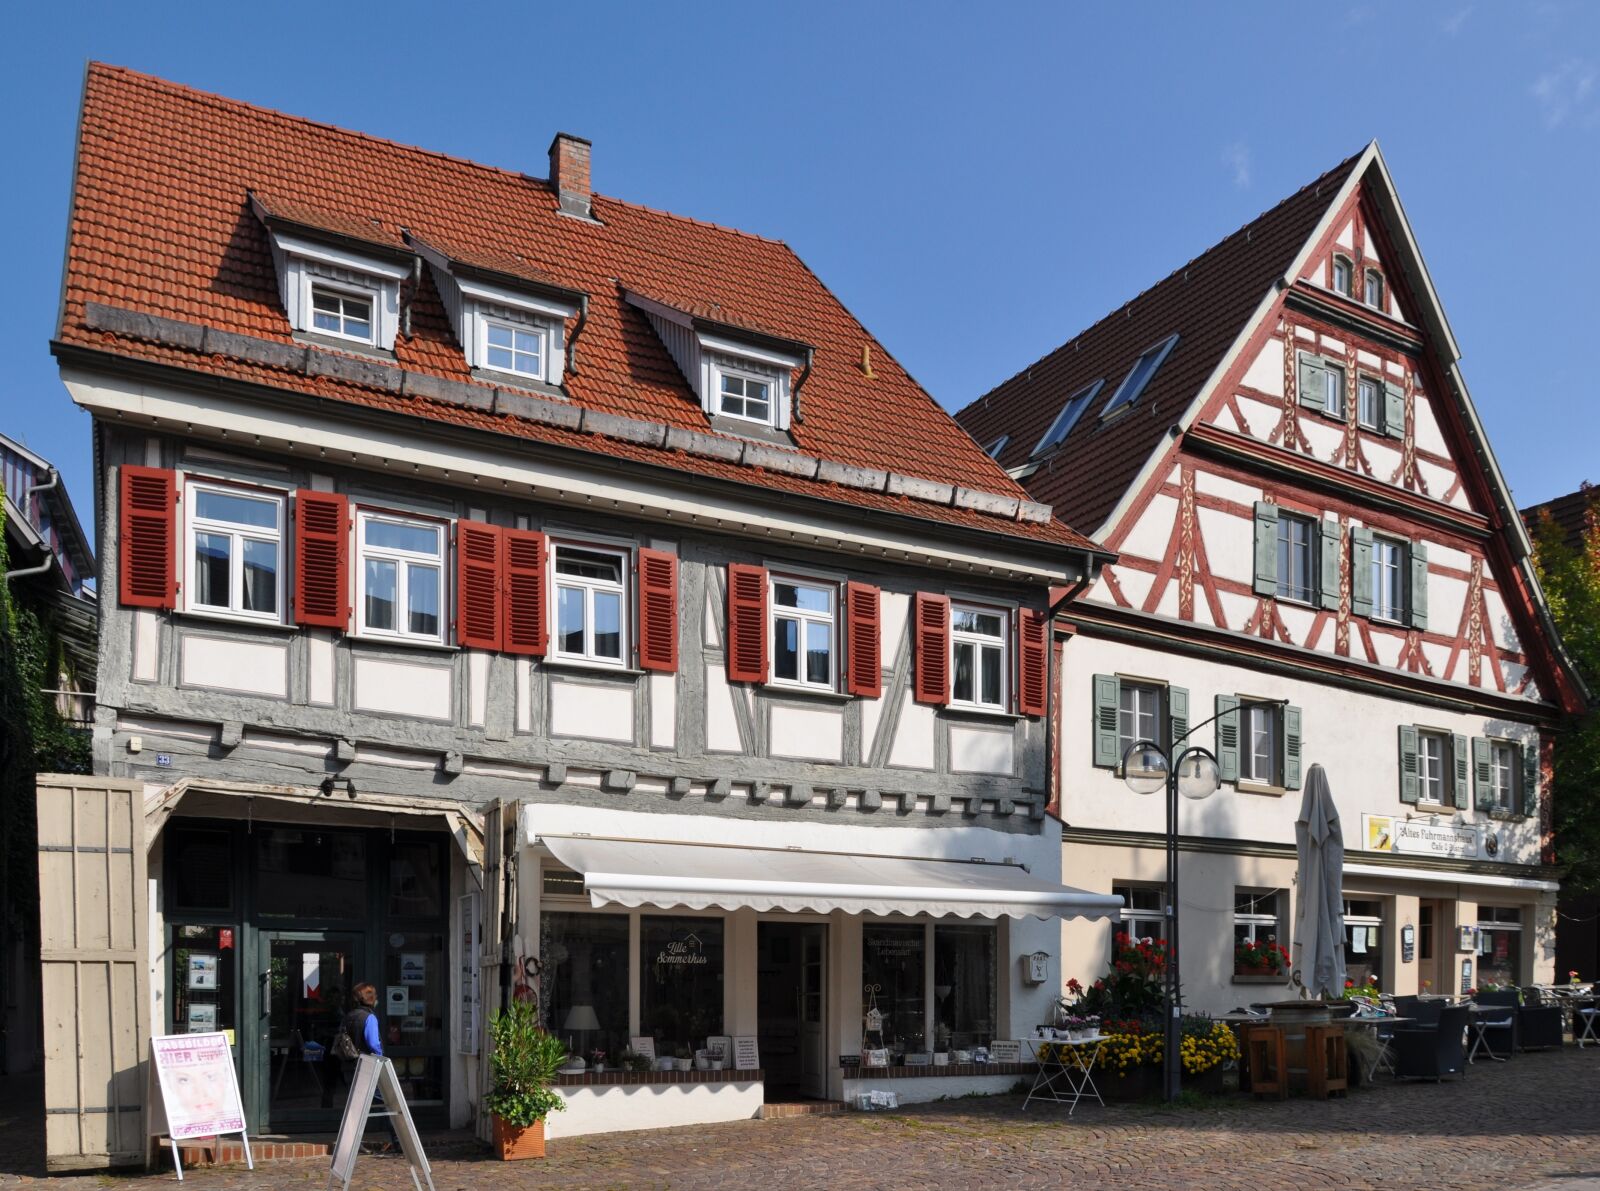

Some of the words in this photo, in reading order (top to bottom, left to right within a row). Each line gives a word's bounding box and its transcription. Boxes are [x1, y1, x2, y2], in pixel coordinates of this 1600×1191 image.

[158, 755, 169, 764] 33
[667, 941, 687, 955] Lille
[657, 951, 707, 964] Sommerhus
[159, 1051, 193, 1065] HIER
